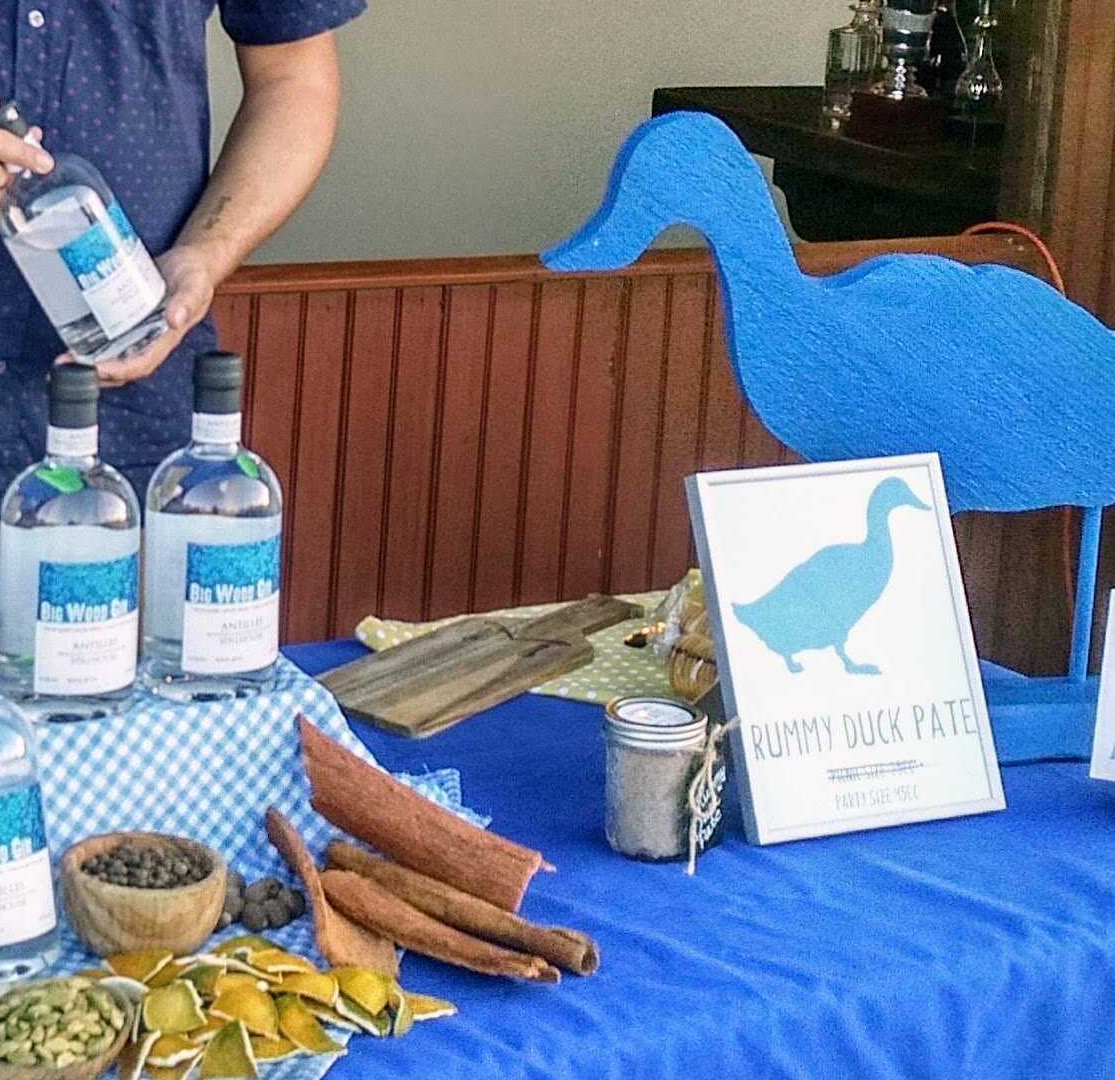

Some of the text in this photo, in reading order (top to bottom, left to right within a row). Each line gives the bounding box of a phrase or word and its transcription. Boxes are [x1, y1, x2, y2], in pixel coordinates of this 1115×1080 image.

[189, 582, 212, 602] BIG
[216, 583, 254, 602] WOOD
[66, 602, 108, 622] WOOD
[751, 698, 978, 760] RUMMY DUCK PATE
[835, 791, 866, 810] PARTY
[869, 787, 892, 806] SIZE
